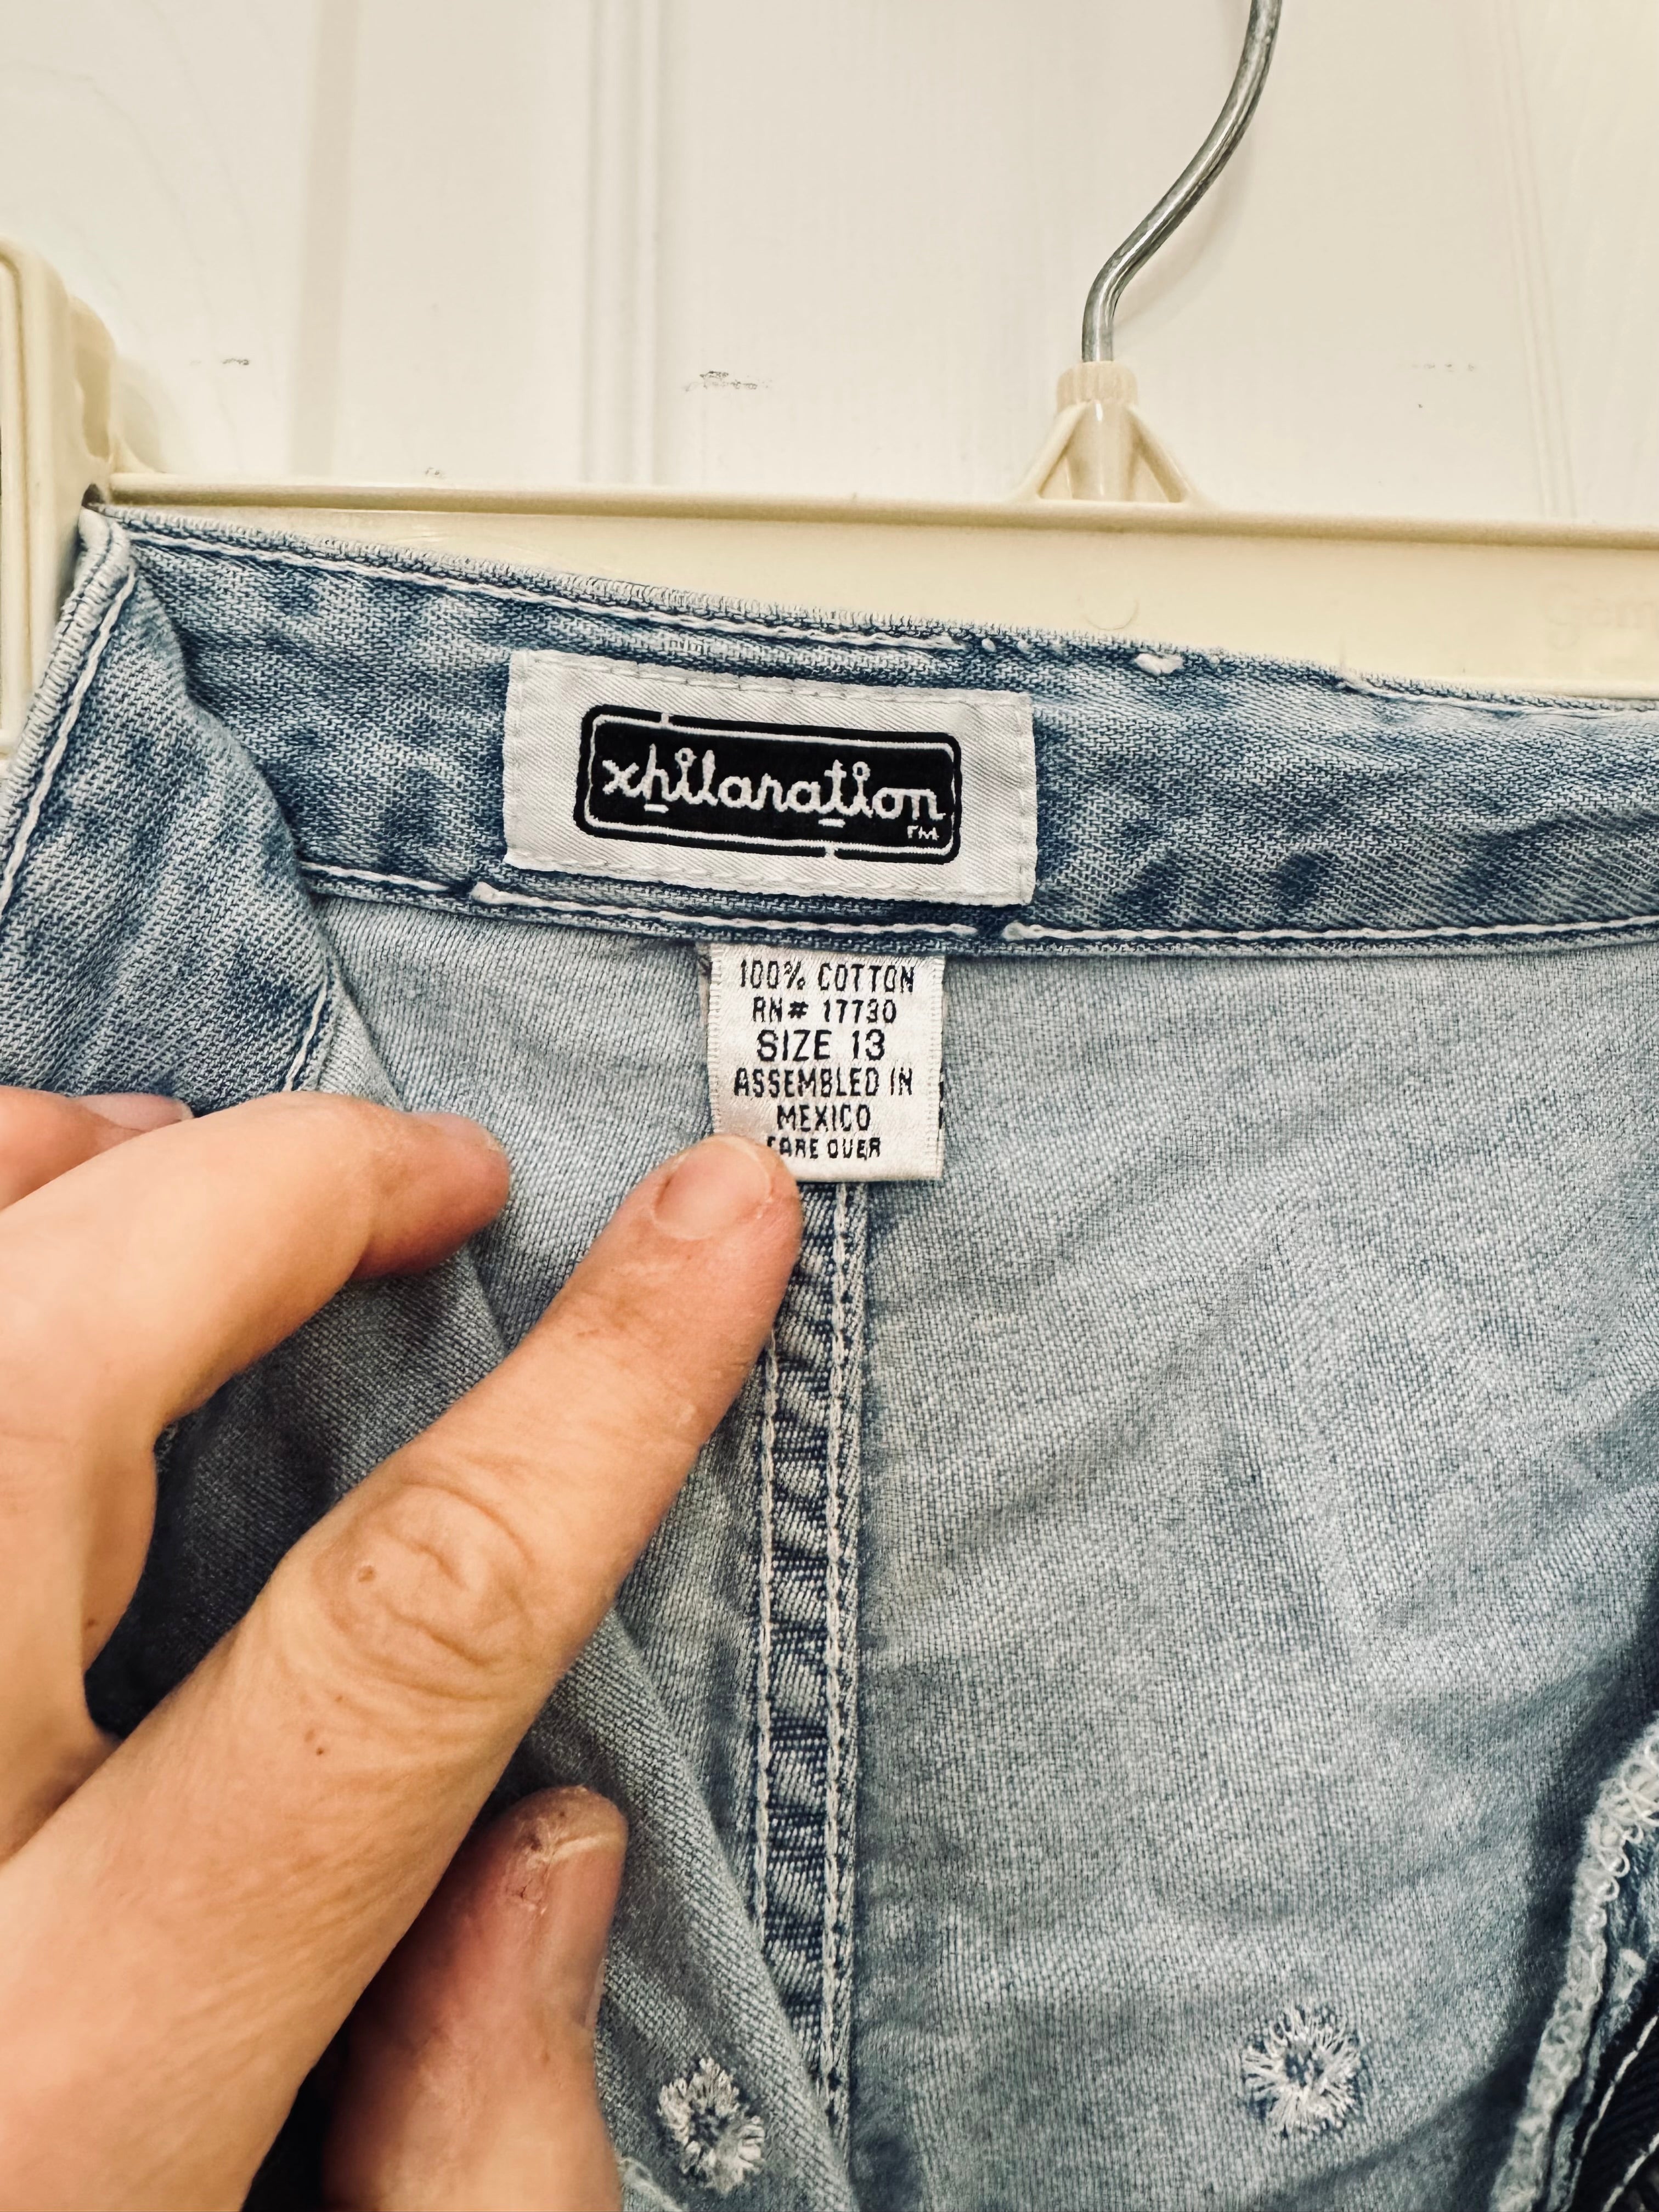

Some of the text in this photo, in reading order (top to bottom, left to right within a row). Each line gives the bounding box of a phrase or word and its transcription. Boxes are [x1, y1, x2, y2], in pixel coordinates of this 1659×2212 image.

[602, 743, 946, 820] xhilaration
[741, 959, 916, 993] 100% COTTON
[752, 996, 896, 1024] RN# 17730
[757, 1029, 885, 1062] SIZE 13
[734, 1067, 913, 1098] ASSEMBLED IN
[777, 1104, 871, 1132] MEXICO
[827, 1137, 881, 1160] OVER
